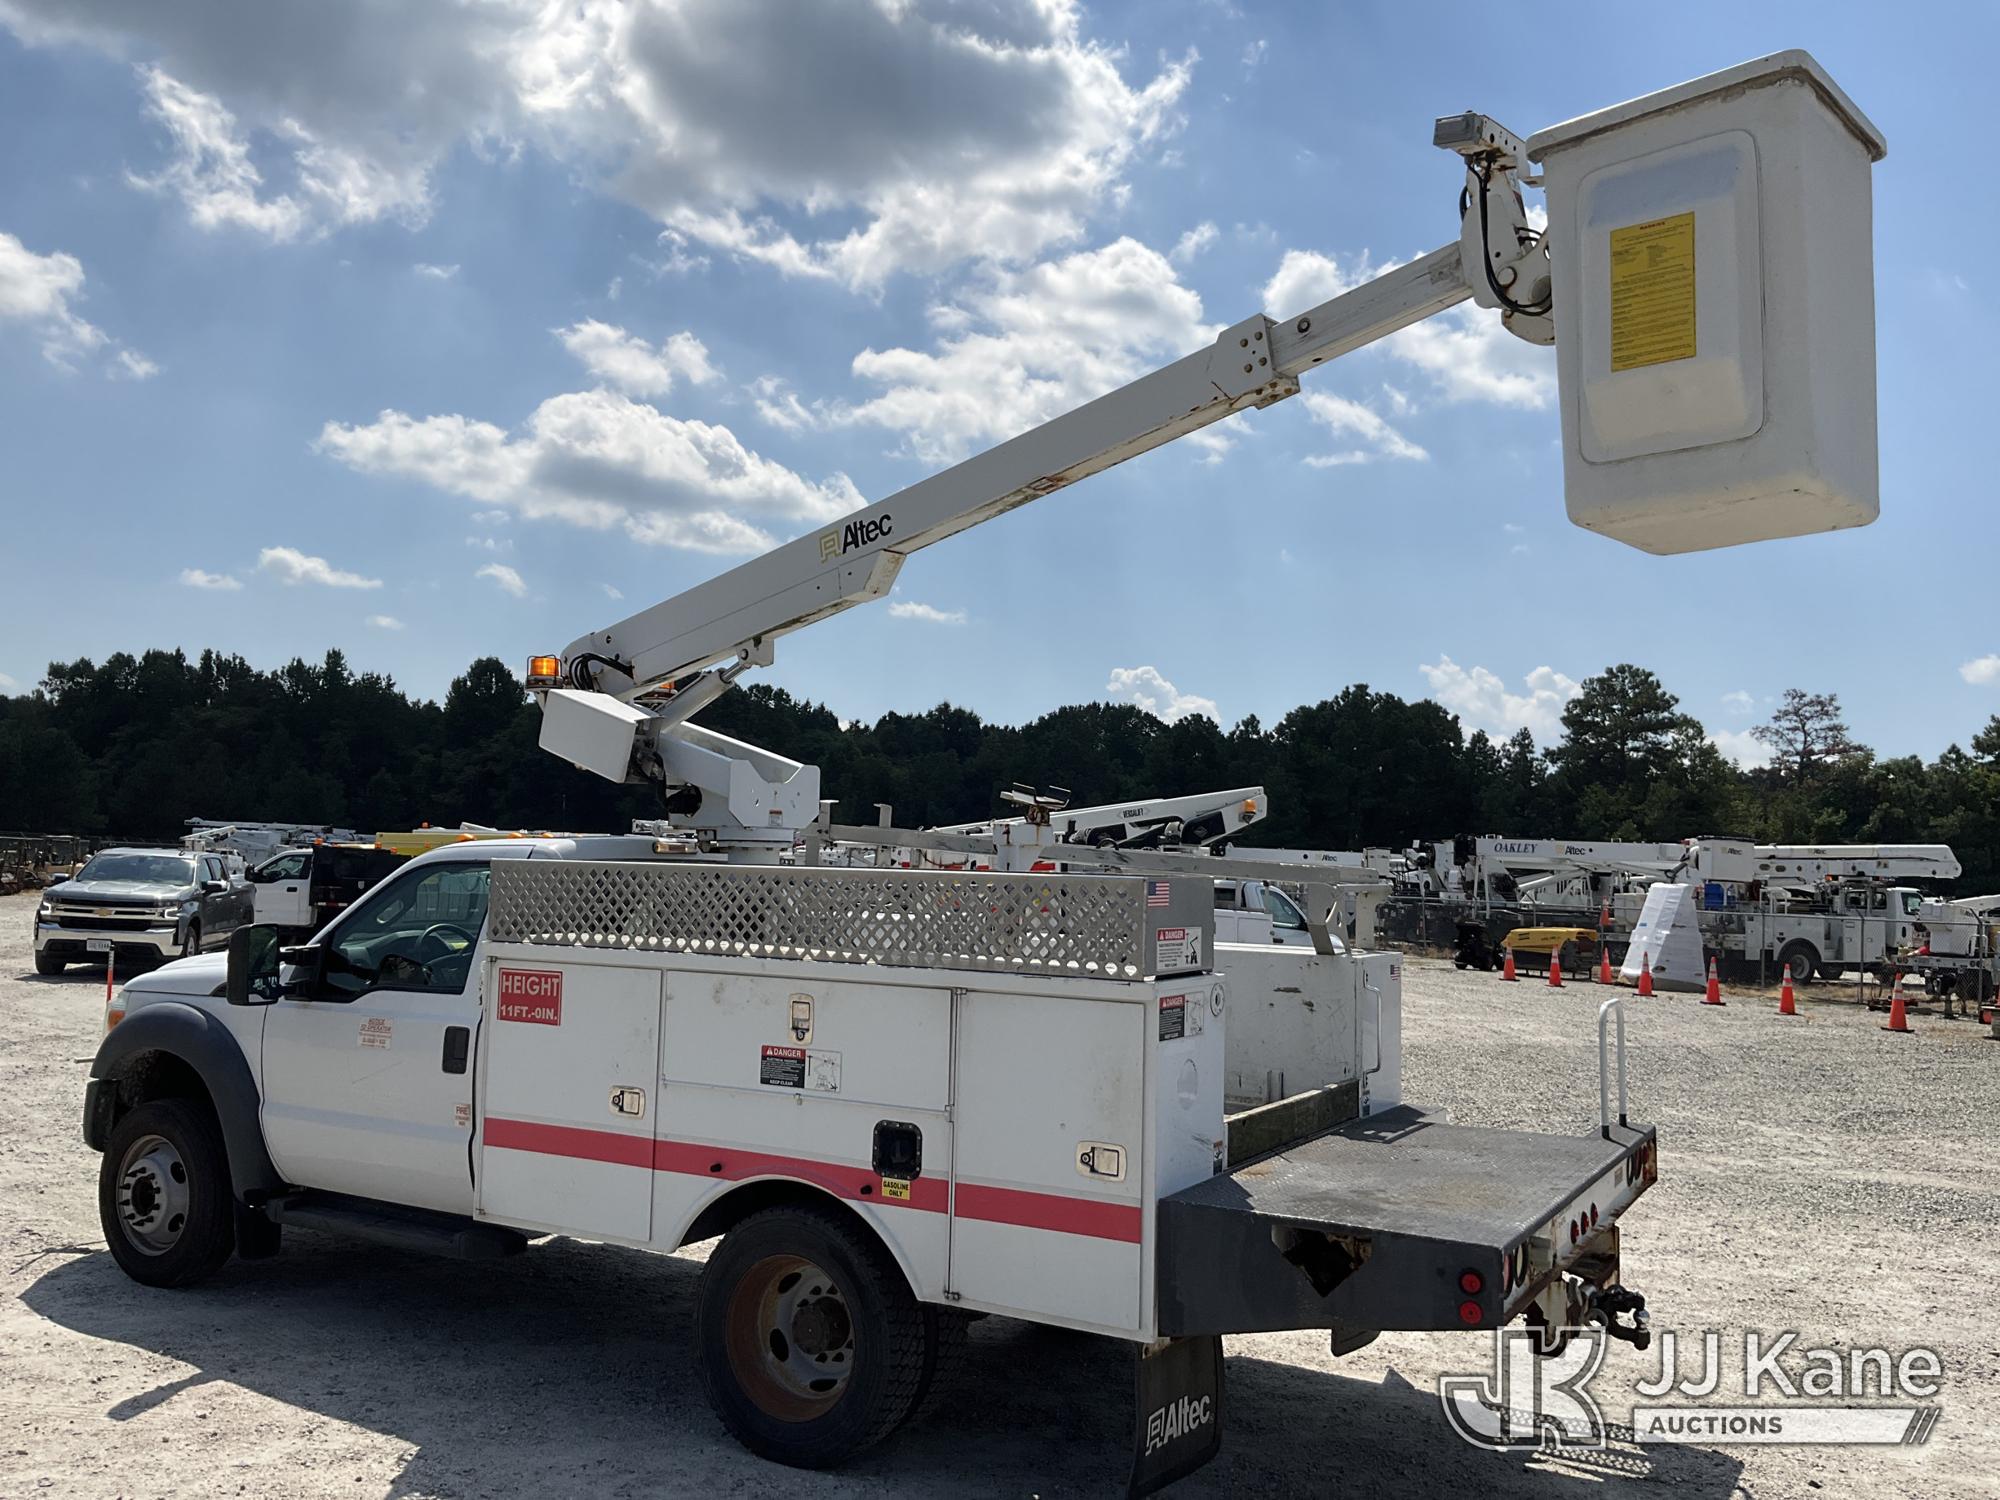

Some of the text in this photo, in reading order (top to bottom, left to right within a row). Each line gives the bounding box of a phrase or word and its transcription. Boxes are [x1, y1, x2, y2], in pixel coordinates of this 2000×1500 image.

[842, 513, 893, 555] Altec
[1494, 842, 1538, 854] OAKLEY
[1564, 844, 1586, 855] Altec
[1164, 930, 1184, 940] DANGER
[501, 974, 560, 997] HEIGHT
[773, 1047, 802, 1058] DANGER
[882, 1180, 909, 1191] GASOLINE
[888, 1189, 903, 1197] ONLY
[1163, 1394, 1210, 1445] Altec
